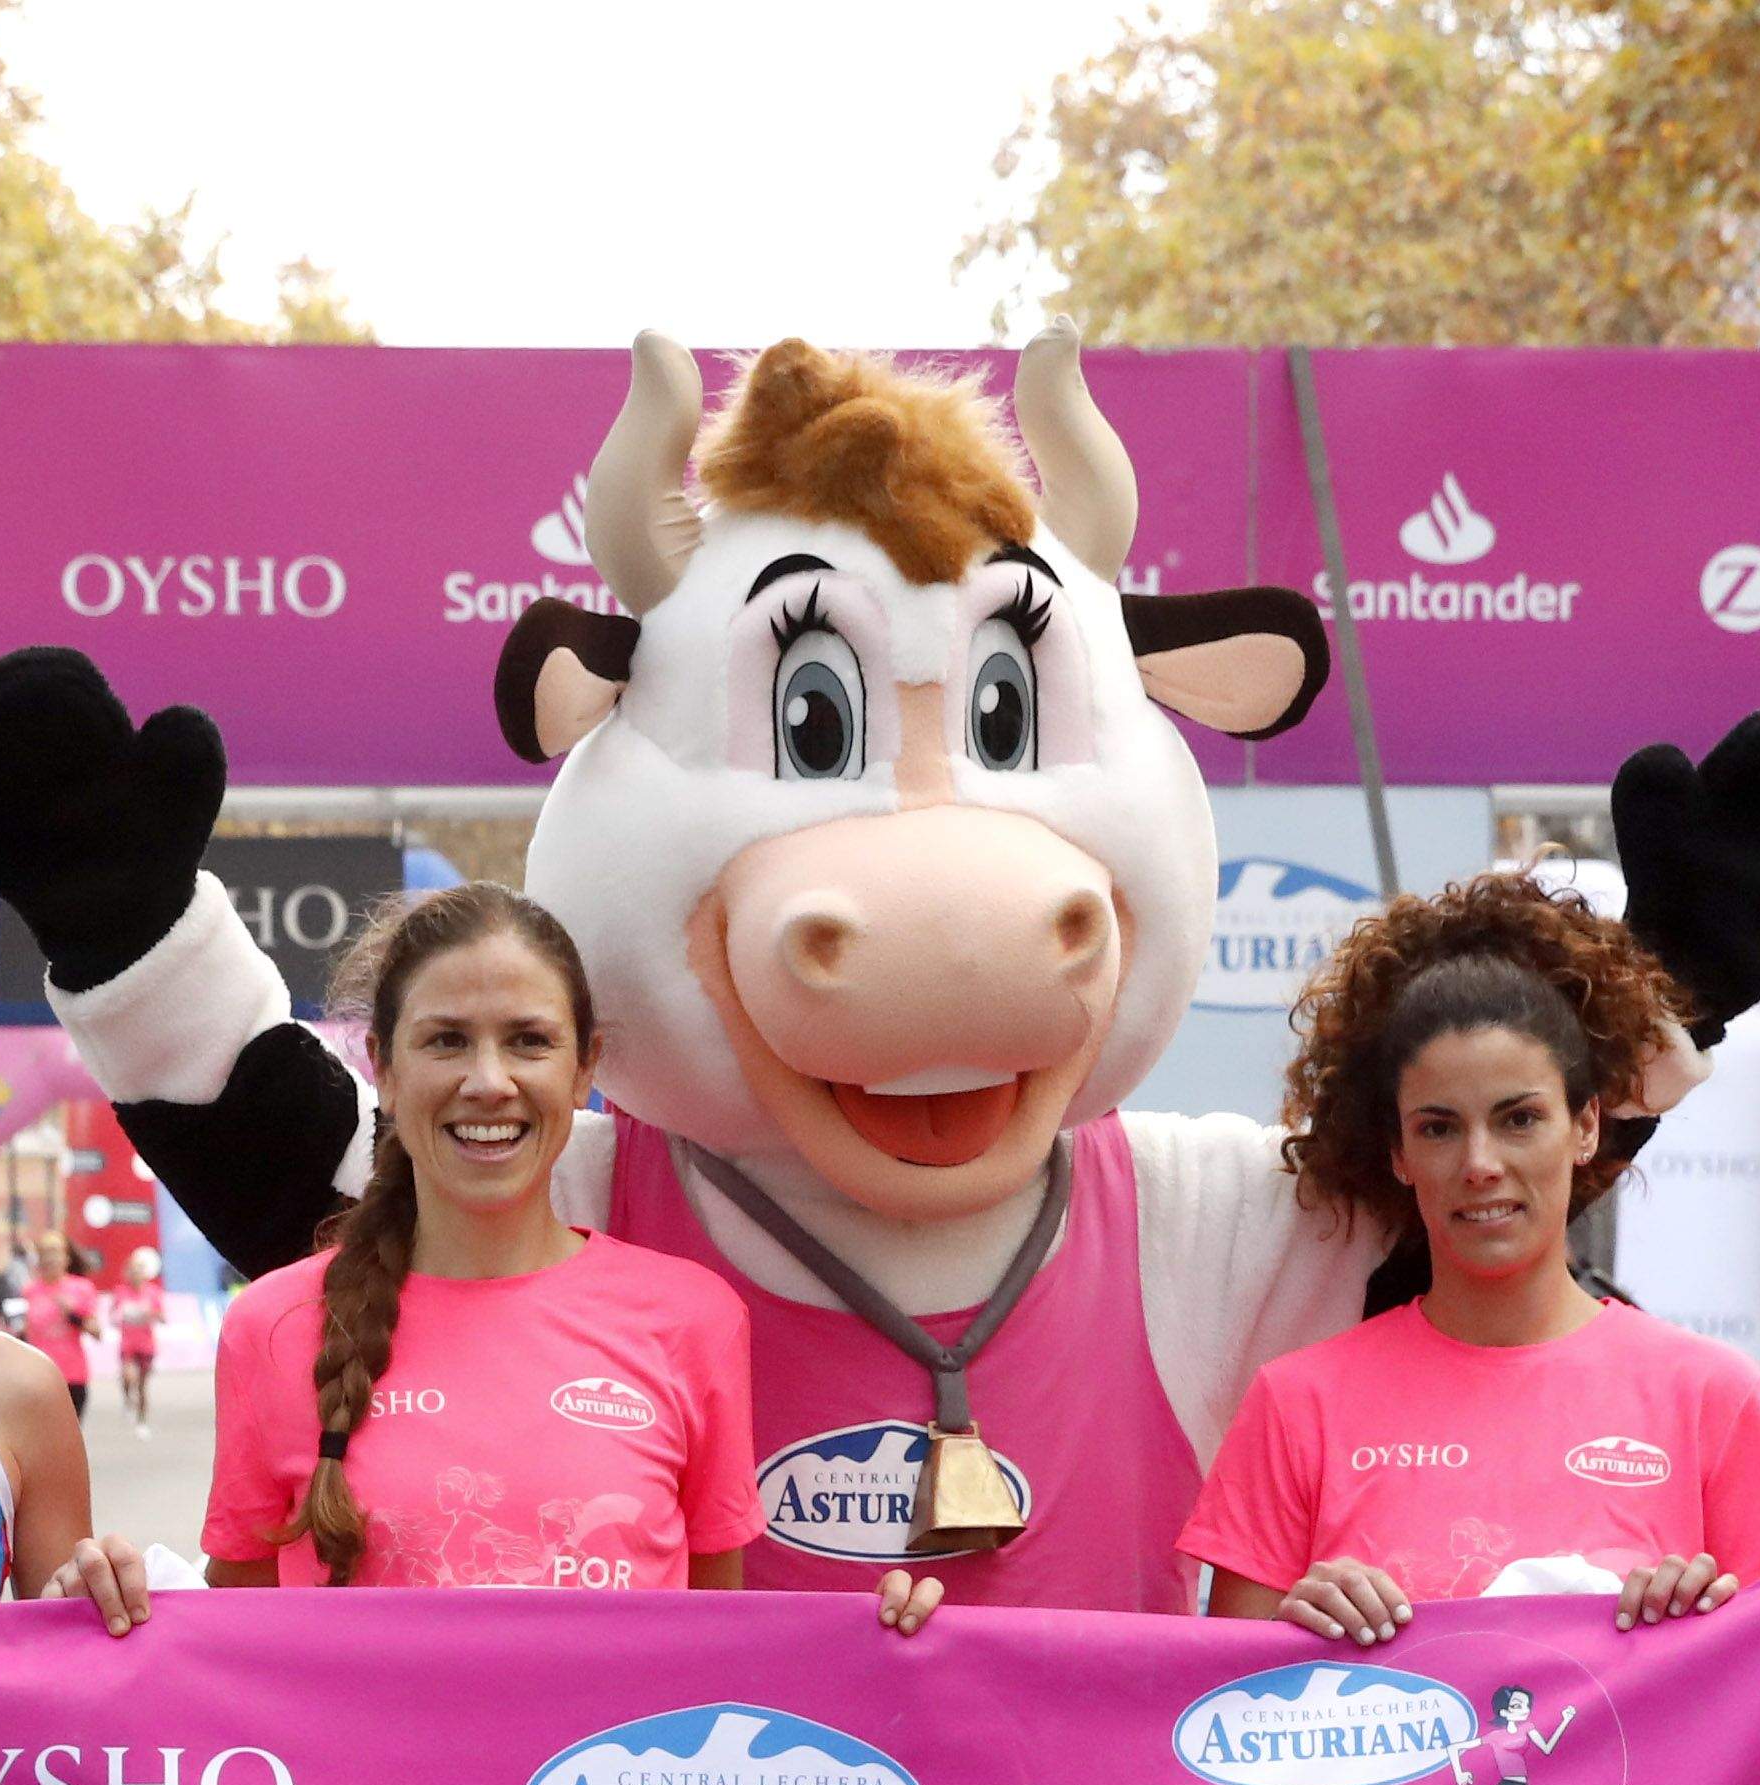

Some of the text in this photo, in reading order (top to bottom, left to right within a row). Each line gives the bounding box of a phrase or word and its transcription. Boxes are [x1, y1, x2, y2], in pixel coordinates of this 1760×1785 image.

[61, 554, 346, 618] OYSHO
[1313, 570, 1580, 622] Santander
[370, 1388, 446, 1417] SHO
[560, 1391, 649, 1423] ASTURIANA
[1352, 1443, 1469, 1471] OYSHO
[1572, 1451, 1665, 1477] ASTURIANA
[814, 1472, 908, 1483] CENTRAL
[553, 1555, 632, 1591] POR
[1242, 1698, 1442, 1724] CENTRAL LECHERA
[1197, 1712, 1448, 1767] ASTURIANA
